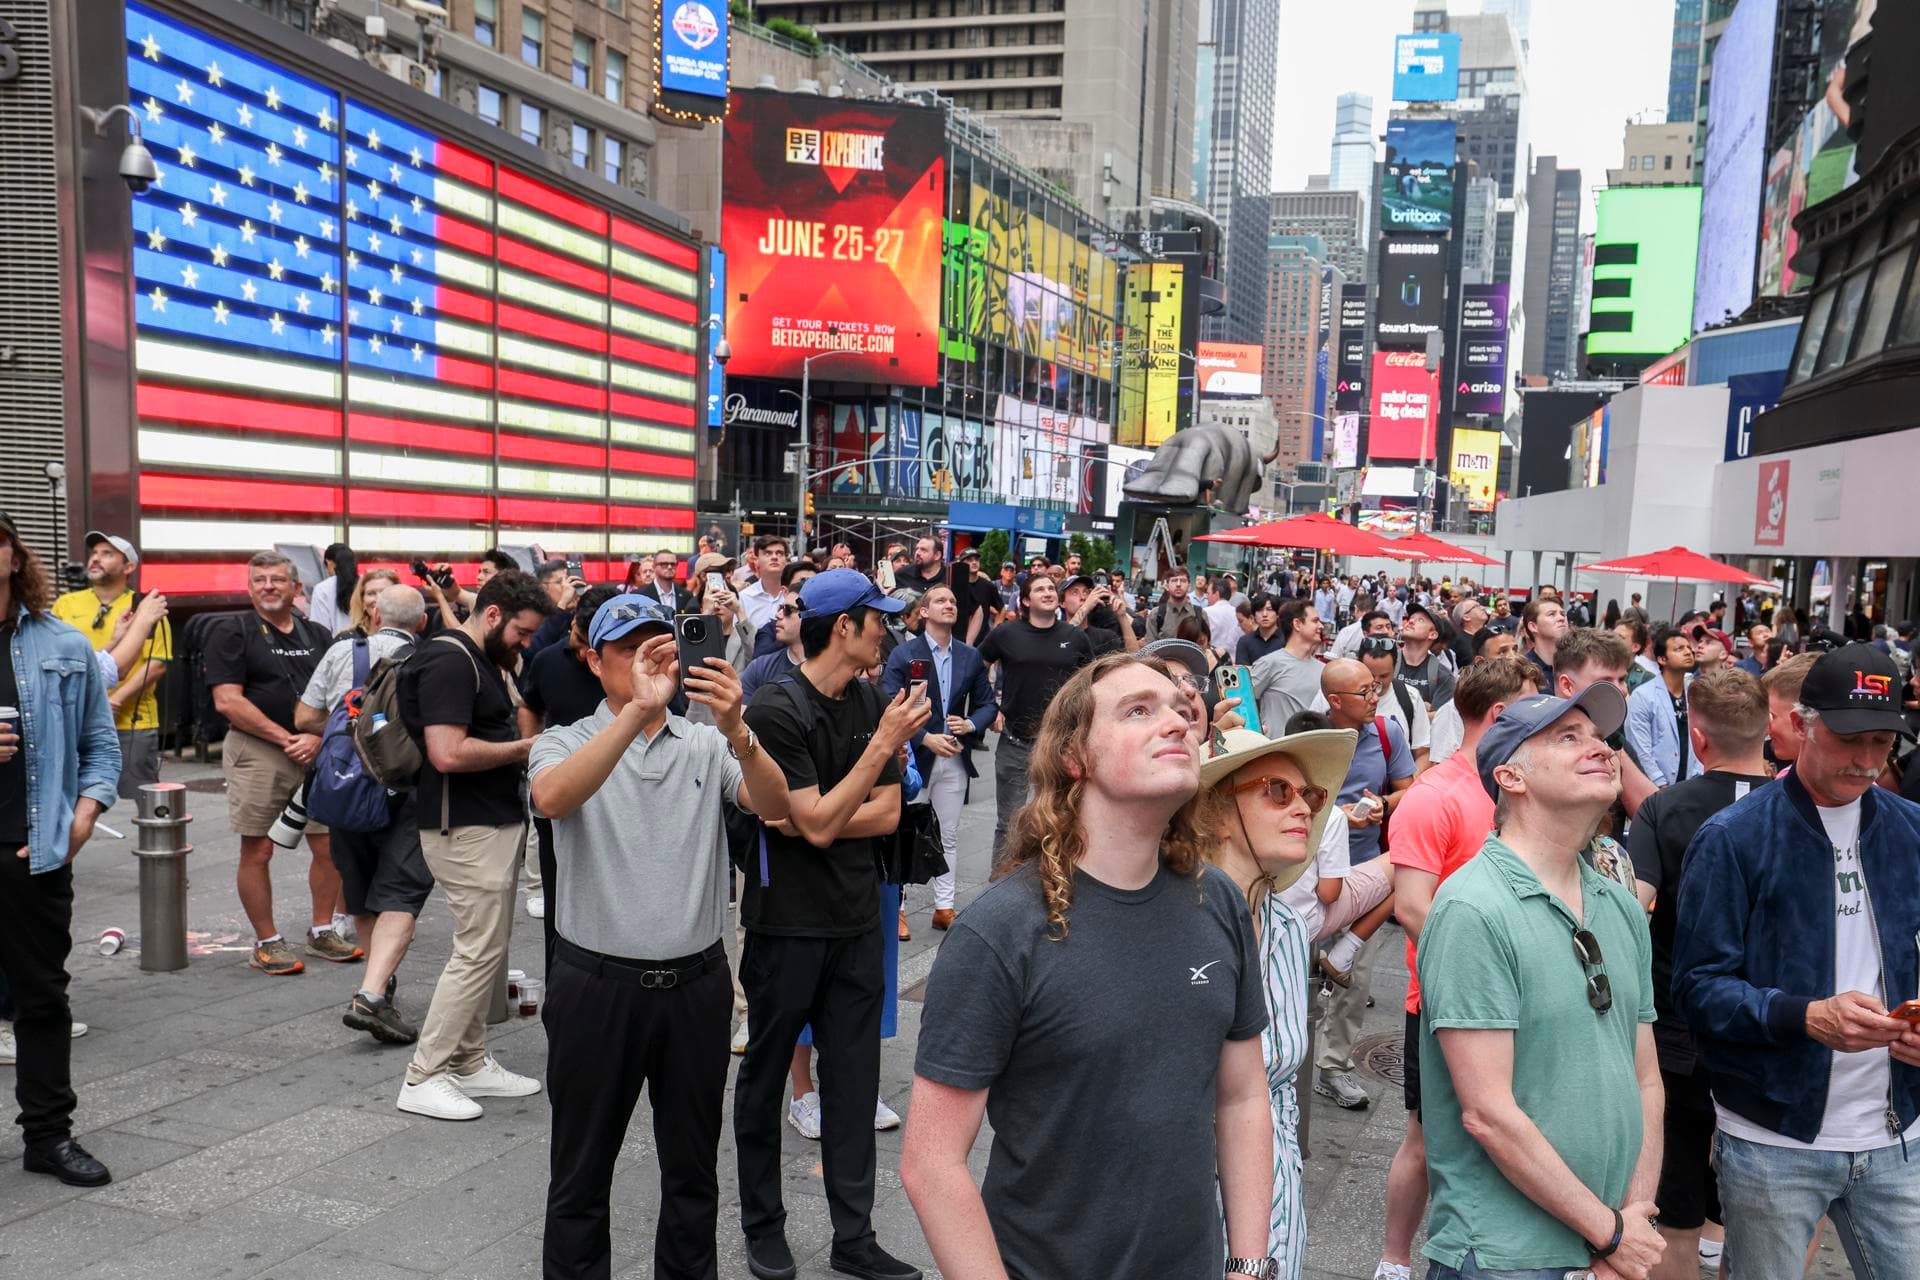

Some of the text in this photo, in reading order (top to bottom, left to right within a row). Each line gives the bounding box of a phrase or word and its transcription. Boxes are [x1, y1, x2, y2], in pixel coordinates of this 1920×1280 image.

[822, 130, 884, 171] EXPERIENCE
[1391, 208, 1440, 222] britbox
[759, 218, 904, 268] JUNE 25-27
[1388, 243, 1439, 254] SAMSUNG
[772, 316, 896, 334] GET YOUR TICKETS NOW
[1379, 323, 1409, 333] Sound
[771, 328, 895, 353] BETEXPERIENCE.COM
[1157, 329, 1174, 338] THE
[1200, 350, 1212, 358] We
[1150, 356, 1177, 369] KING
[1471, 381, 1501, 393] arize
[1381, 389, 1428, 403] mini can
[725, 393, 799, 428] Paramount
[1381, 404, 1427, 420] big deal
[889, 414, 897, 452] NEWS
[952, 436, 994, 490] CB
